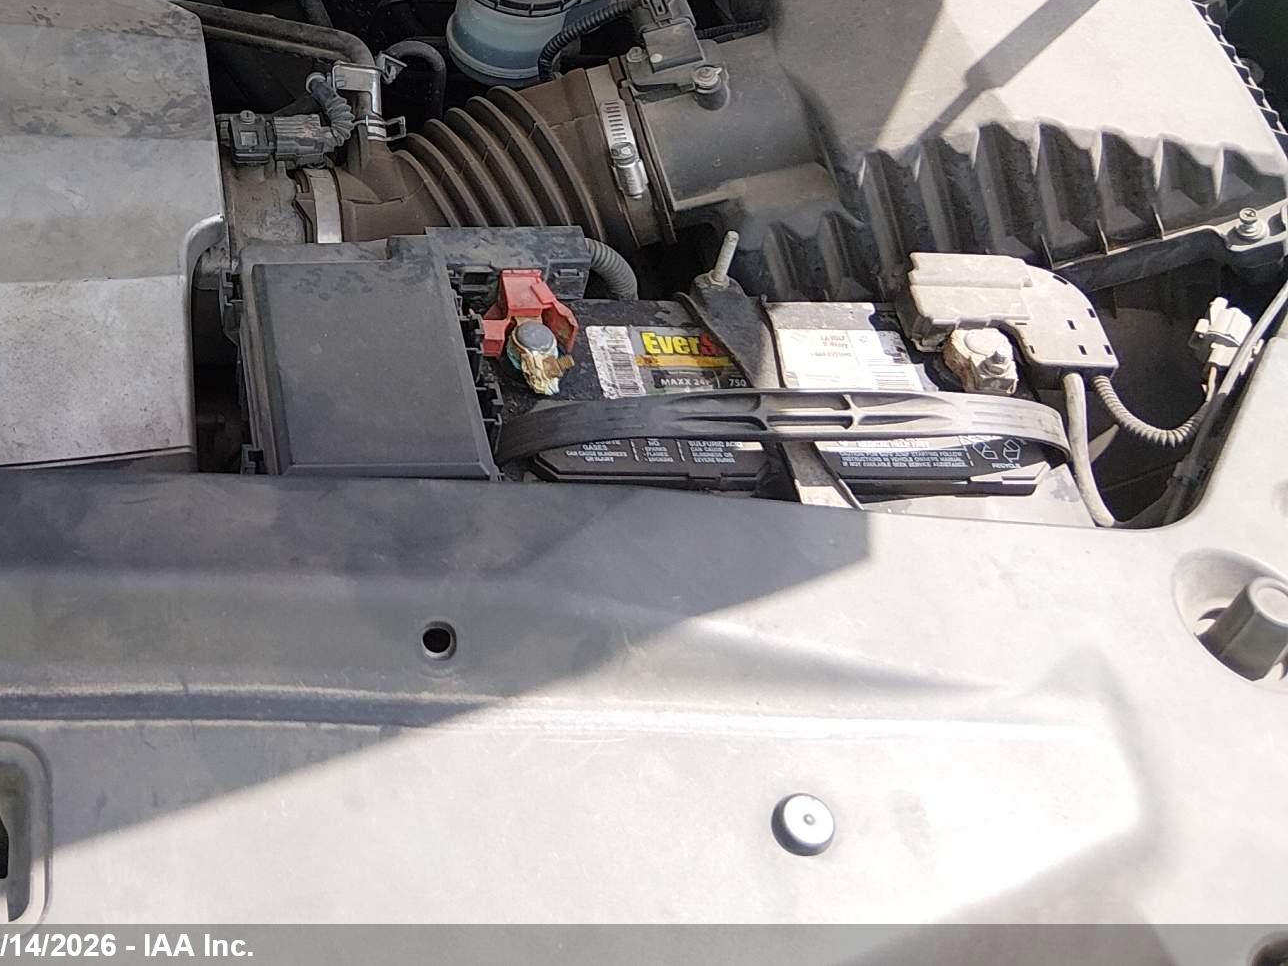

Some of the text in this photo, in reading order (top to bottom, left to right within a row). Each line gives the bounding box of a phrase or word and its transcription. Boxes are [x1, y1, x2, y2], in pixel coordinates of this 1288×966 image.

[640, 331, 724, 355] EverS
[660, 377, 692, 386] MAXX
[728, 378, 747, 387] 750
